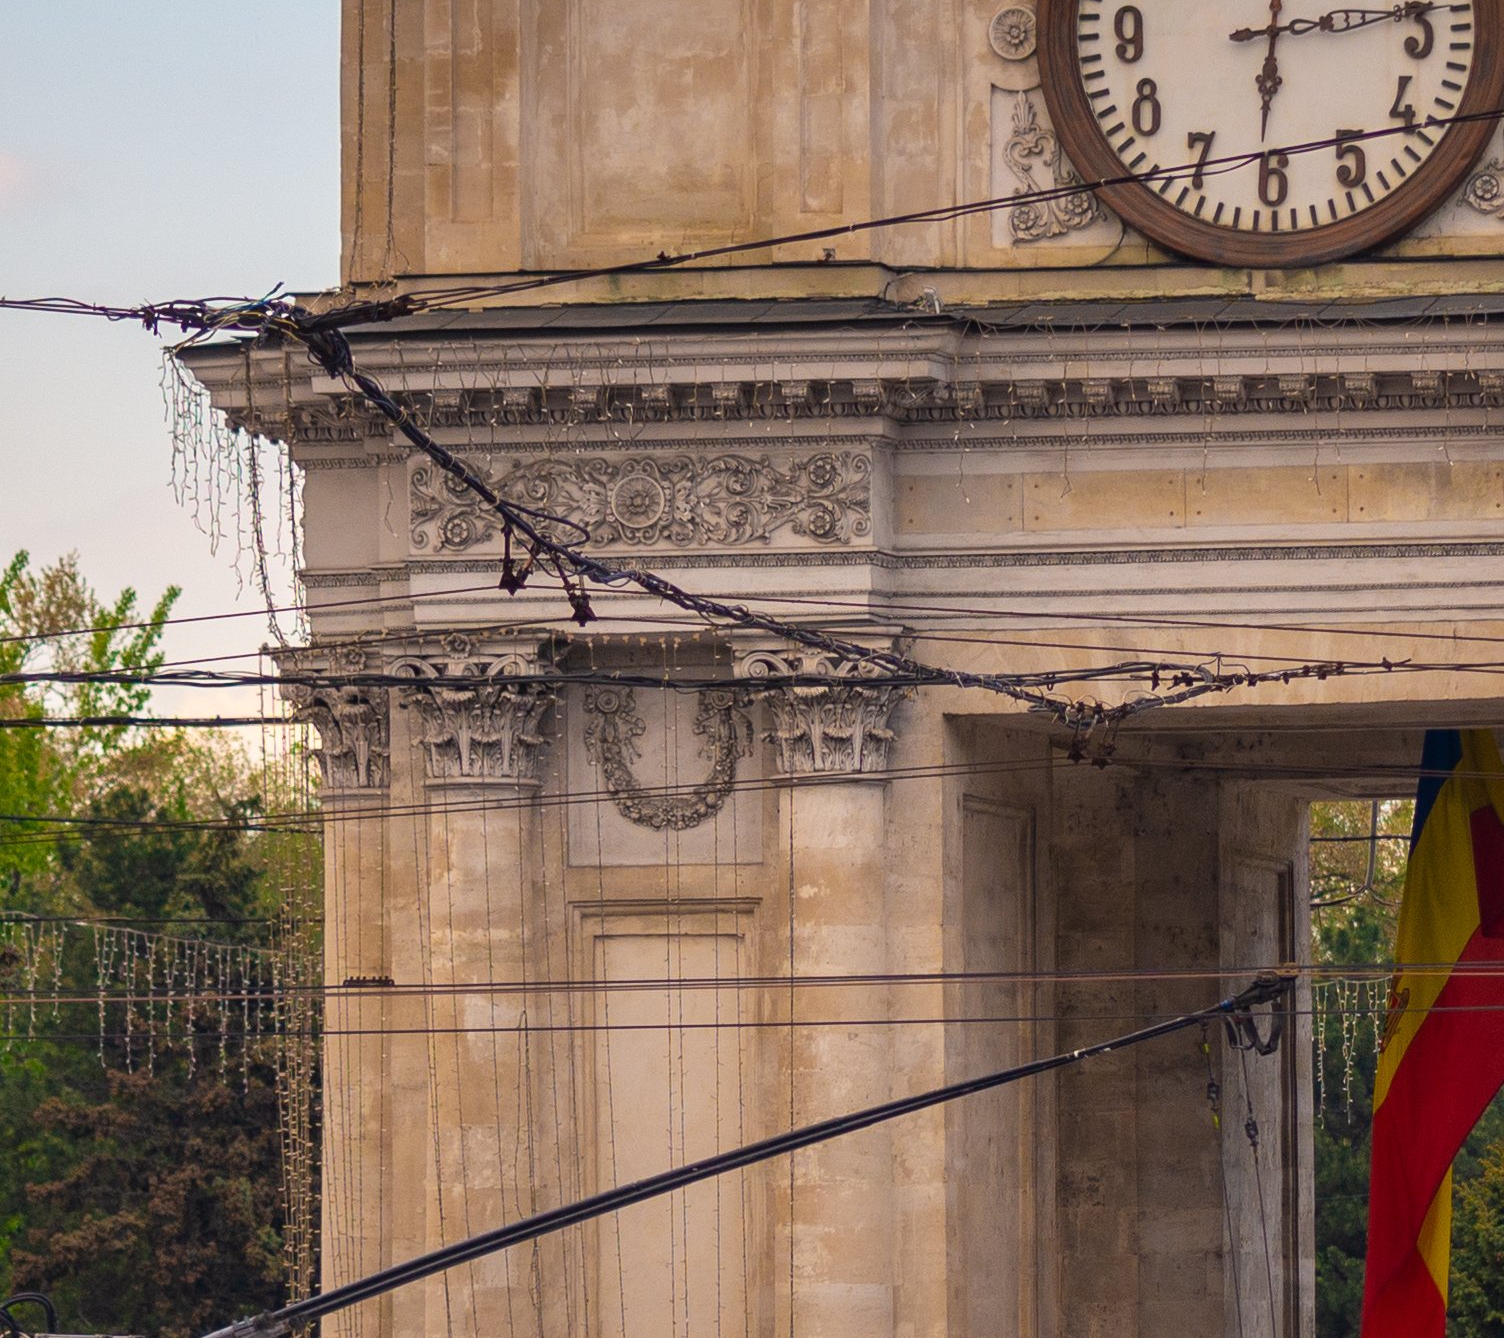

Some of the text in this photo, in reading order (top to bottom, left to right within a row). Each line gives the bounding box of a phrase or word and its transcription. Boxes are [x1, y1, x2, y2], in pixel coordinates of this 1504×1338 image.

[1114, 5, 1144, 63] 9
[1404, 0, 1434, 59] 3
[1132, 78, 1161, 136] 8
[1389, 75, 1416, 135] 4
[1187, 130, 1216, 190] 7
[1258, 148, 1289, 207] 6
[1336, 129, 1366, 188] 5
